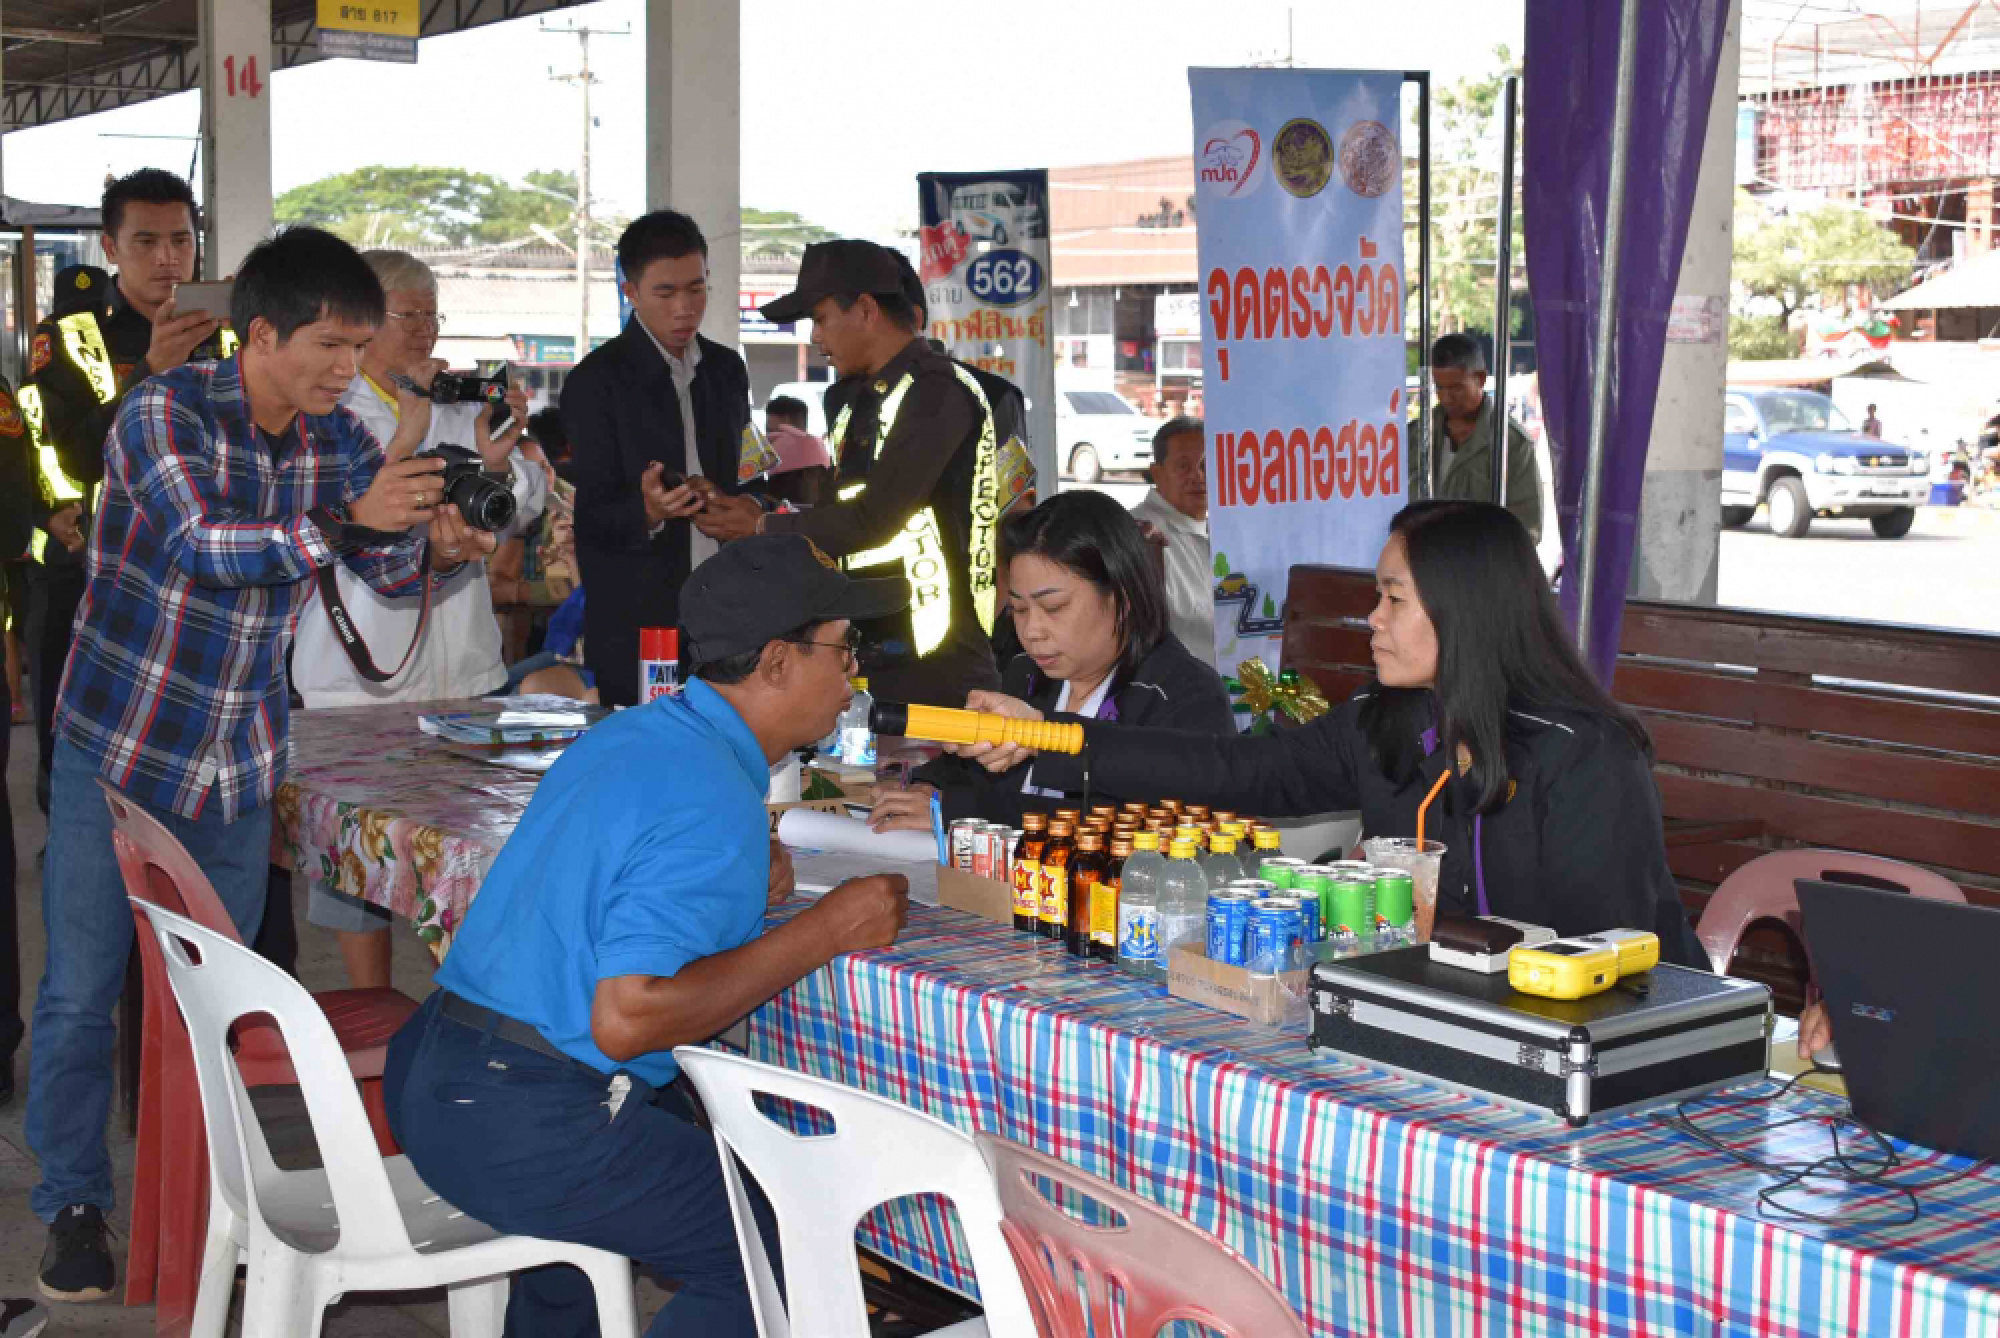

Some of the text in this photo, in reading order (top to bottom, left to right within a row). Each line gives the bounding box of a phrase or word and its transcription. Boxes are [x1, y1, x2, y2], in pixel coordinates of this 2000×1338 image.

[224, 55, 263, 98] 14
[973, 259, 1033, 296] 562
[1207, 235, 1400, 381] จุดตรวจวัด
[1214, 387, 1400, 507] แอลกอฮอล์
[974, 428, 996, 592] SPECTOR
[331, 605, 355, 644] Canon
